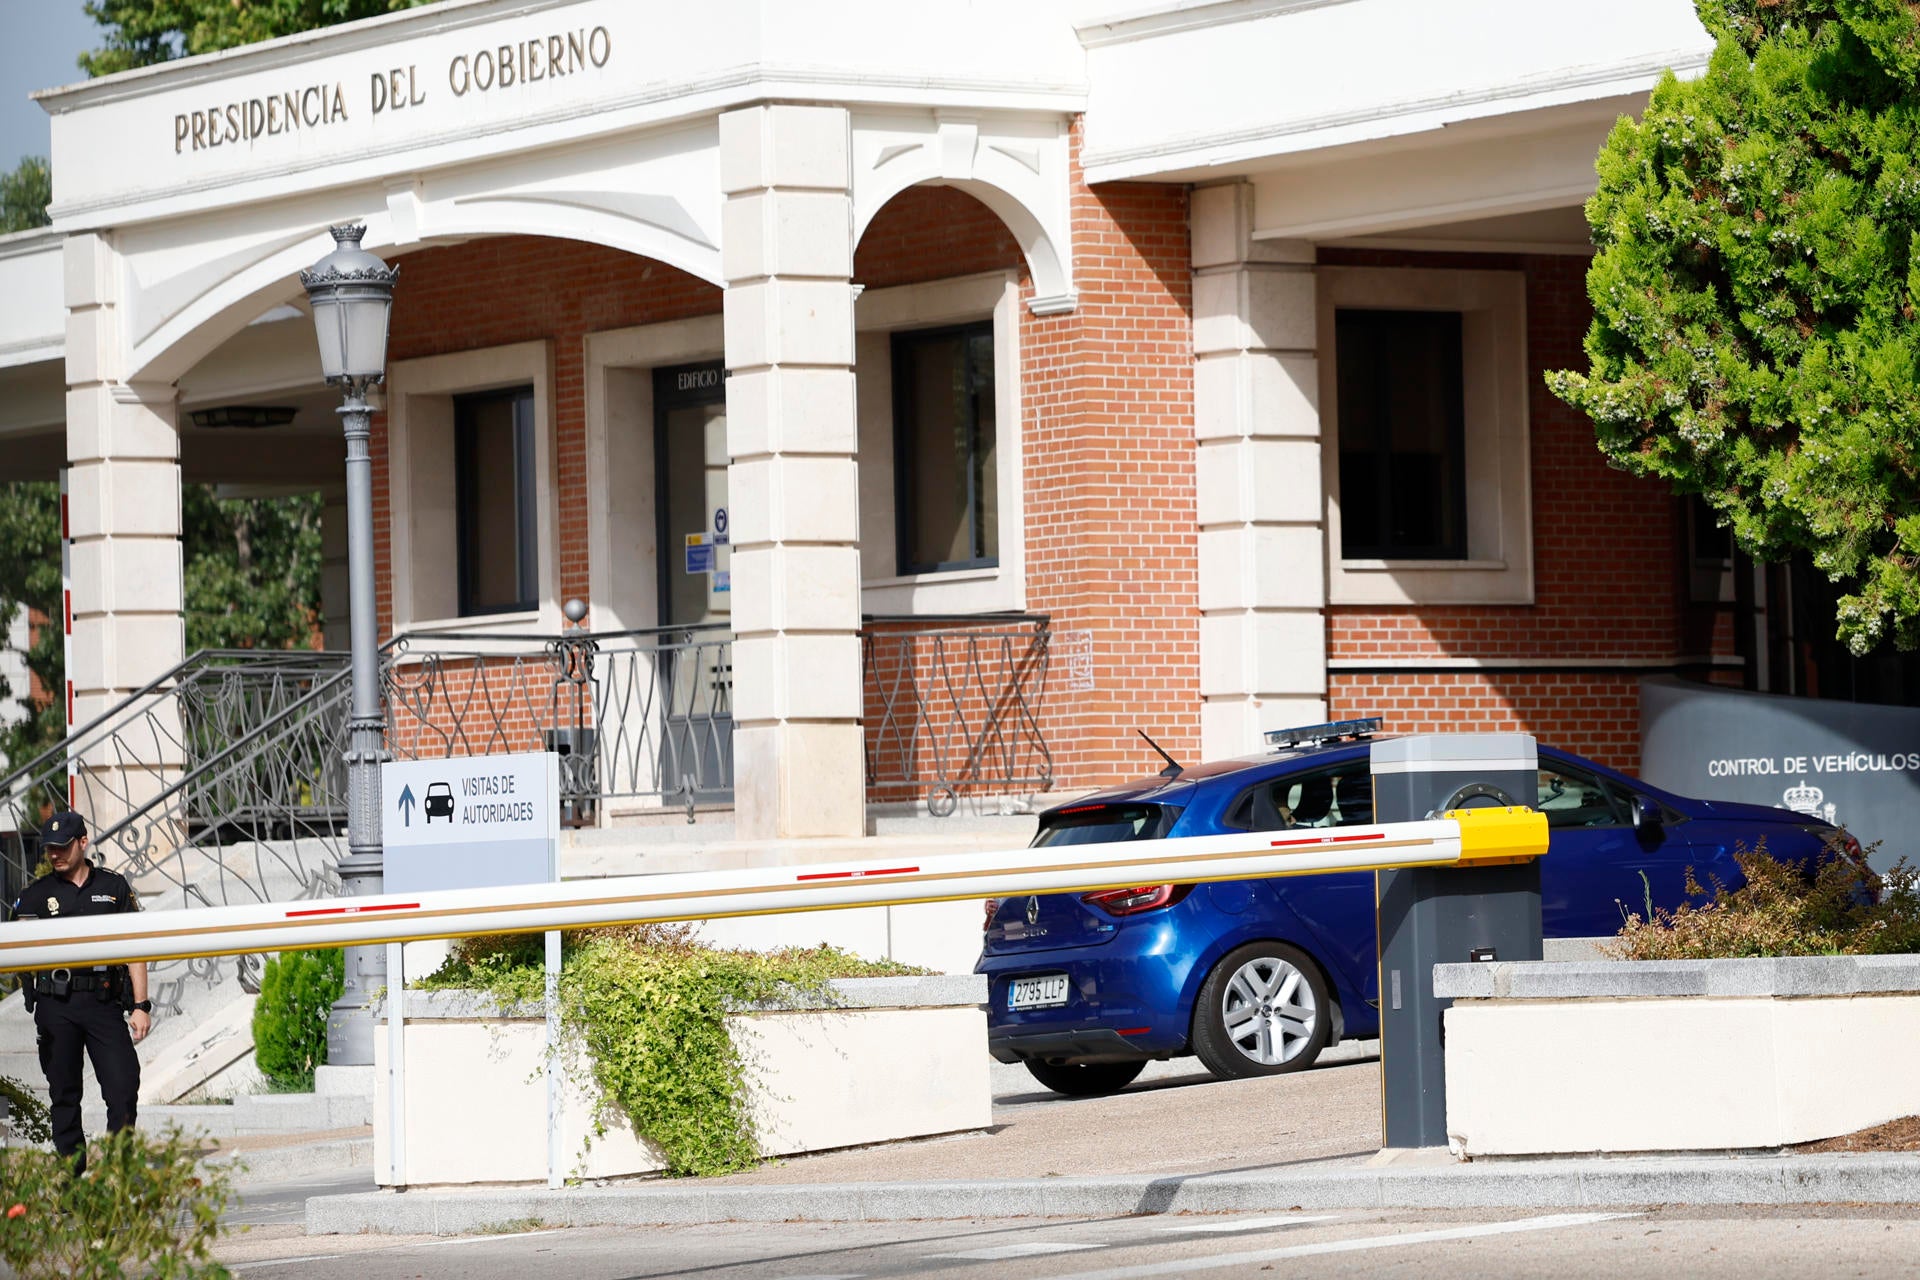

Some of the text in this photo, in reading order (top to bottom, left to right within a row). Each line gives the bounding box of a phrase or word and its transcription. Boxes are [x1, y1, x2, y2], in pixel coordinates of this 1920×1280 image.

[174, 25, 611, 155] PRESIDENCIA DEL GOBIERNO
[678, 369, 718, 390] EDIFICIO
[1708, 751, 1920, 777] CONTROL DE VEHÍCULOS
[461, 774, 515, 797] VISITAS DE
[462, 801, 533, 824] AUTORIDADES
[1014, 978, 1065, 1003] 2795 LLP
